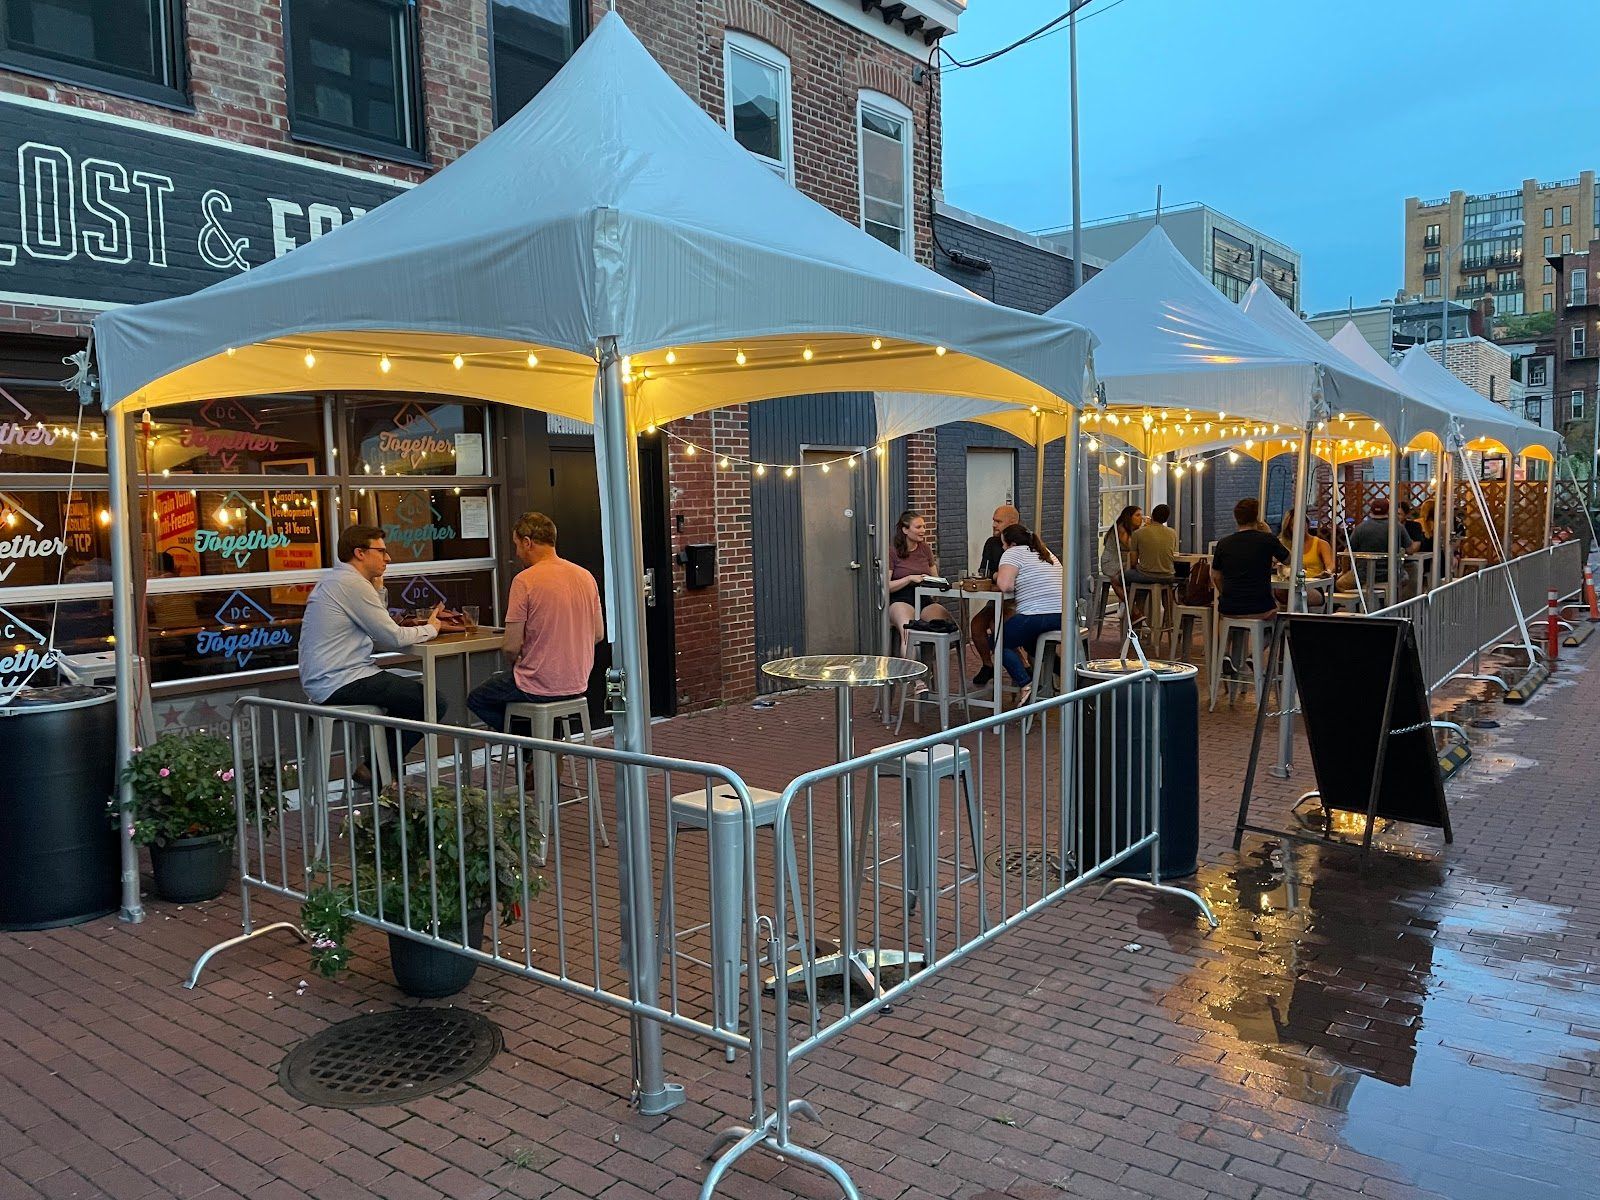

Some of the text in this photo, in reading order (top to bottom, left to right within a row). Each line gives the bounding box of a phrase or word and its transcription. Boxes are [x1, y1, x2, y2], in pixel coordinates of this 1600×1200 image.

[0, 141, 174, 266] OST
[198, 189, 251, 271] &
[216, 406, 236, 420] DC
[181, 426, 279, 457] Together
[379, 431, 456, 459] Together
[284, 521, 292, 535] 31
[292, 521, 311, 535] Years
[382, 523, 456, 548] Together
[73, 533, 92, 553] TCP
[194, 529, 291, 559] Together
[413, 587, 429, 599] DC
[230, 605, 251, 620] DC
[196, 627, 293, 658] Together
